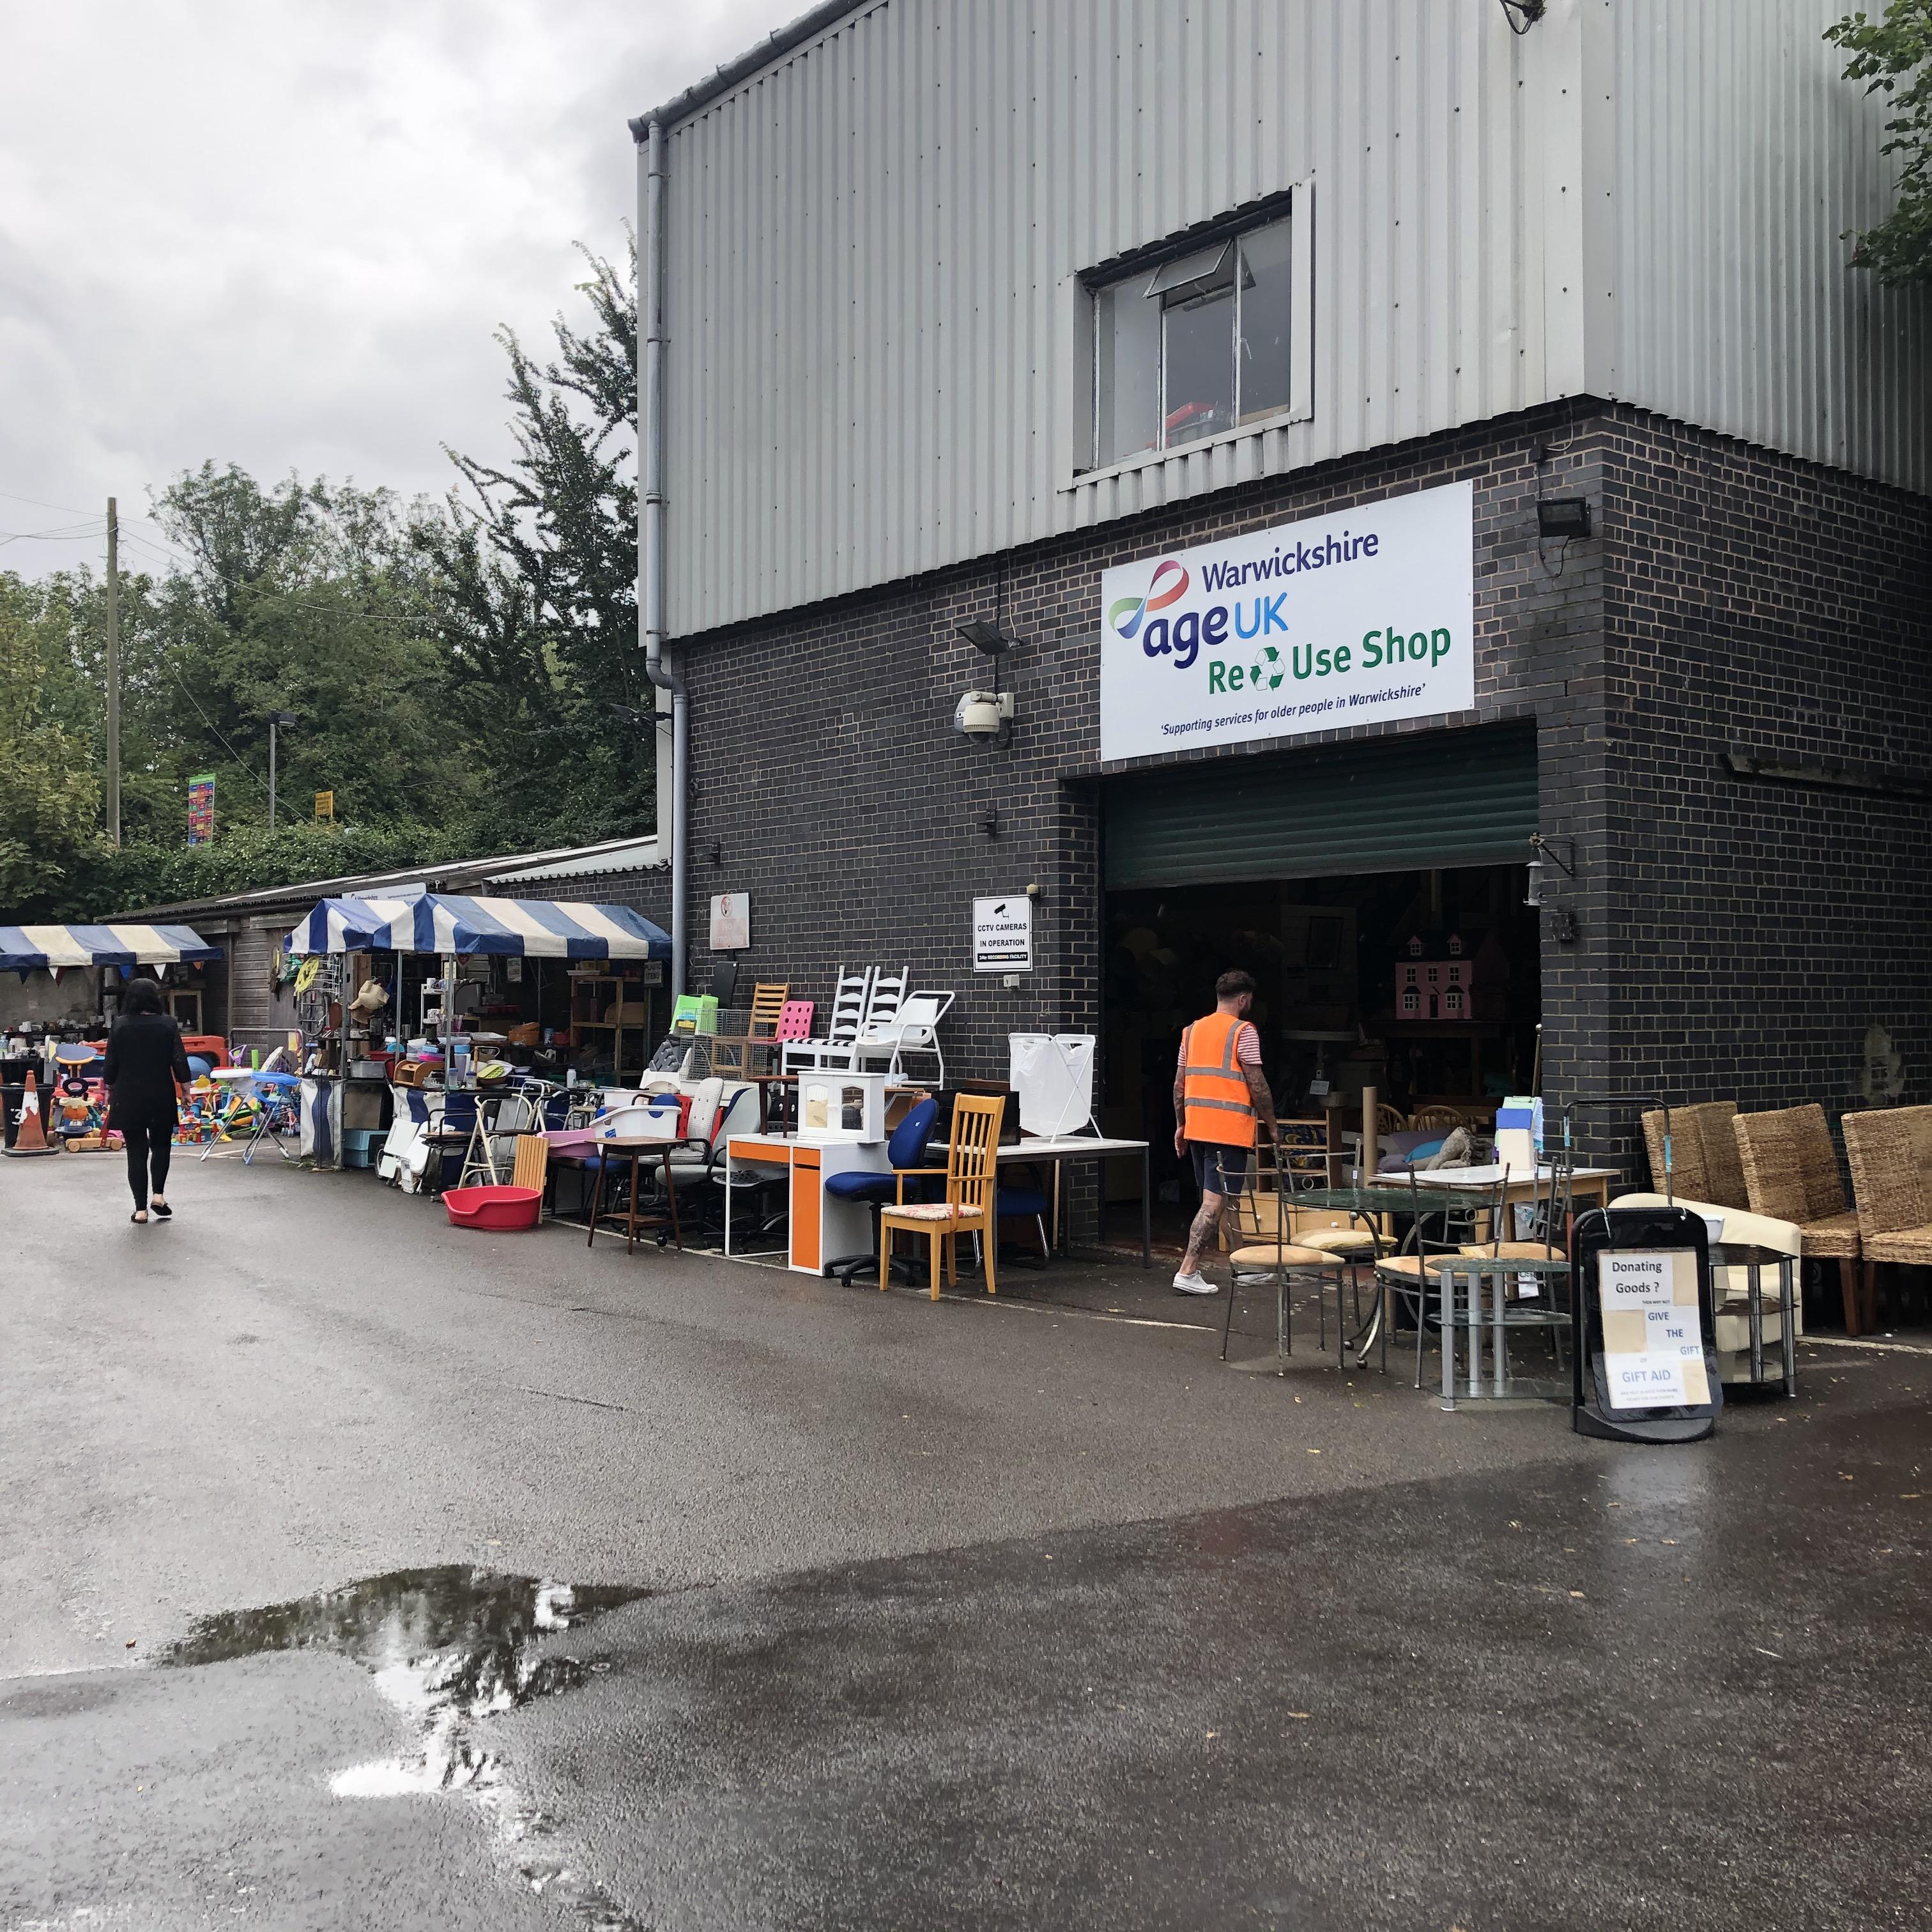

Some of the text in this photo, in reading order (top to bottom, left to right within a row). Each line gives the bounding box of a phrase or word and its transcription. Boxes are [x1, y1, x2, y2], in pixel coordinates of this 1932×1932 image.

[1201, 530, 1379, 593] Warwickshire
[1209, 626, 1451, 694] Re Use Shop
[1214, 710, 1253, 728] services
[1255, 709, 1269, 724] for
[1270, 705, 1298, 719] older
[1298, 698, 1333, 717] people
[1335, 697, 1346, 709] in
[995, 923, 1027, 931] CAMERAS
[988, 939, 1025, 947] OPERATION
[1612, 1261, 1662, 1273] Donating
[1615, 1282, 1651, 1294] Goods
[1648, 1312, 1669, 1321] GIVE
[1666, 1329, 1683, 1337] THE
[1680, 1346, 1699, 1355] GIFT
[1621, 1369, 1671, 1383] GIFT AID
